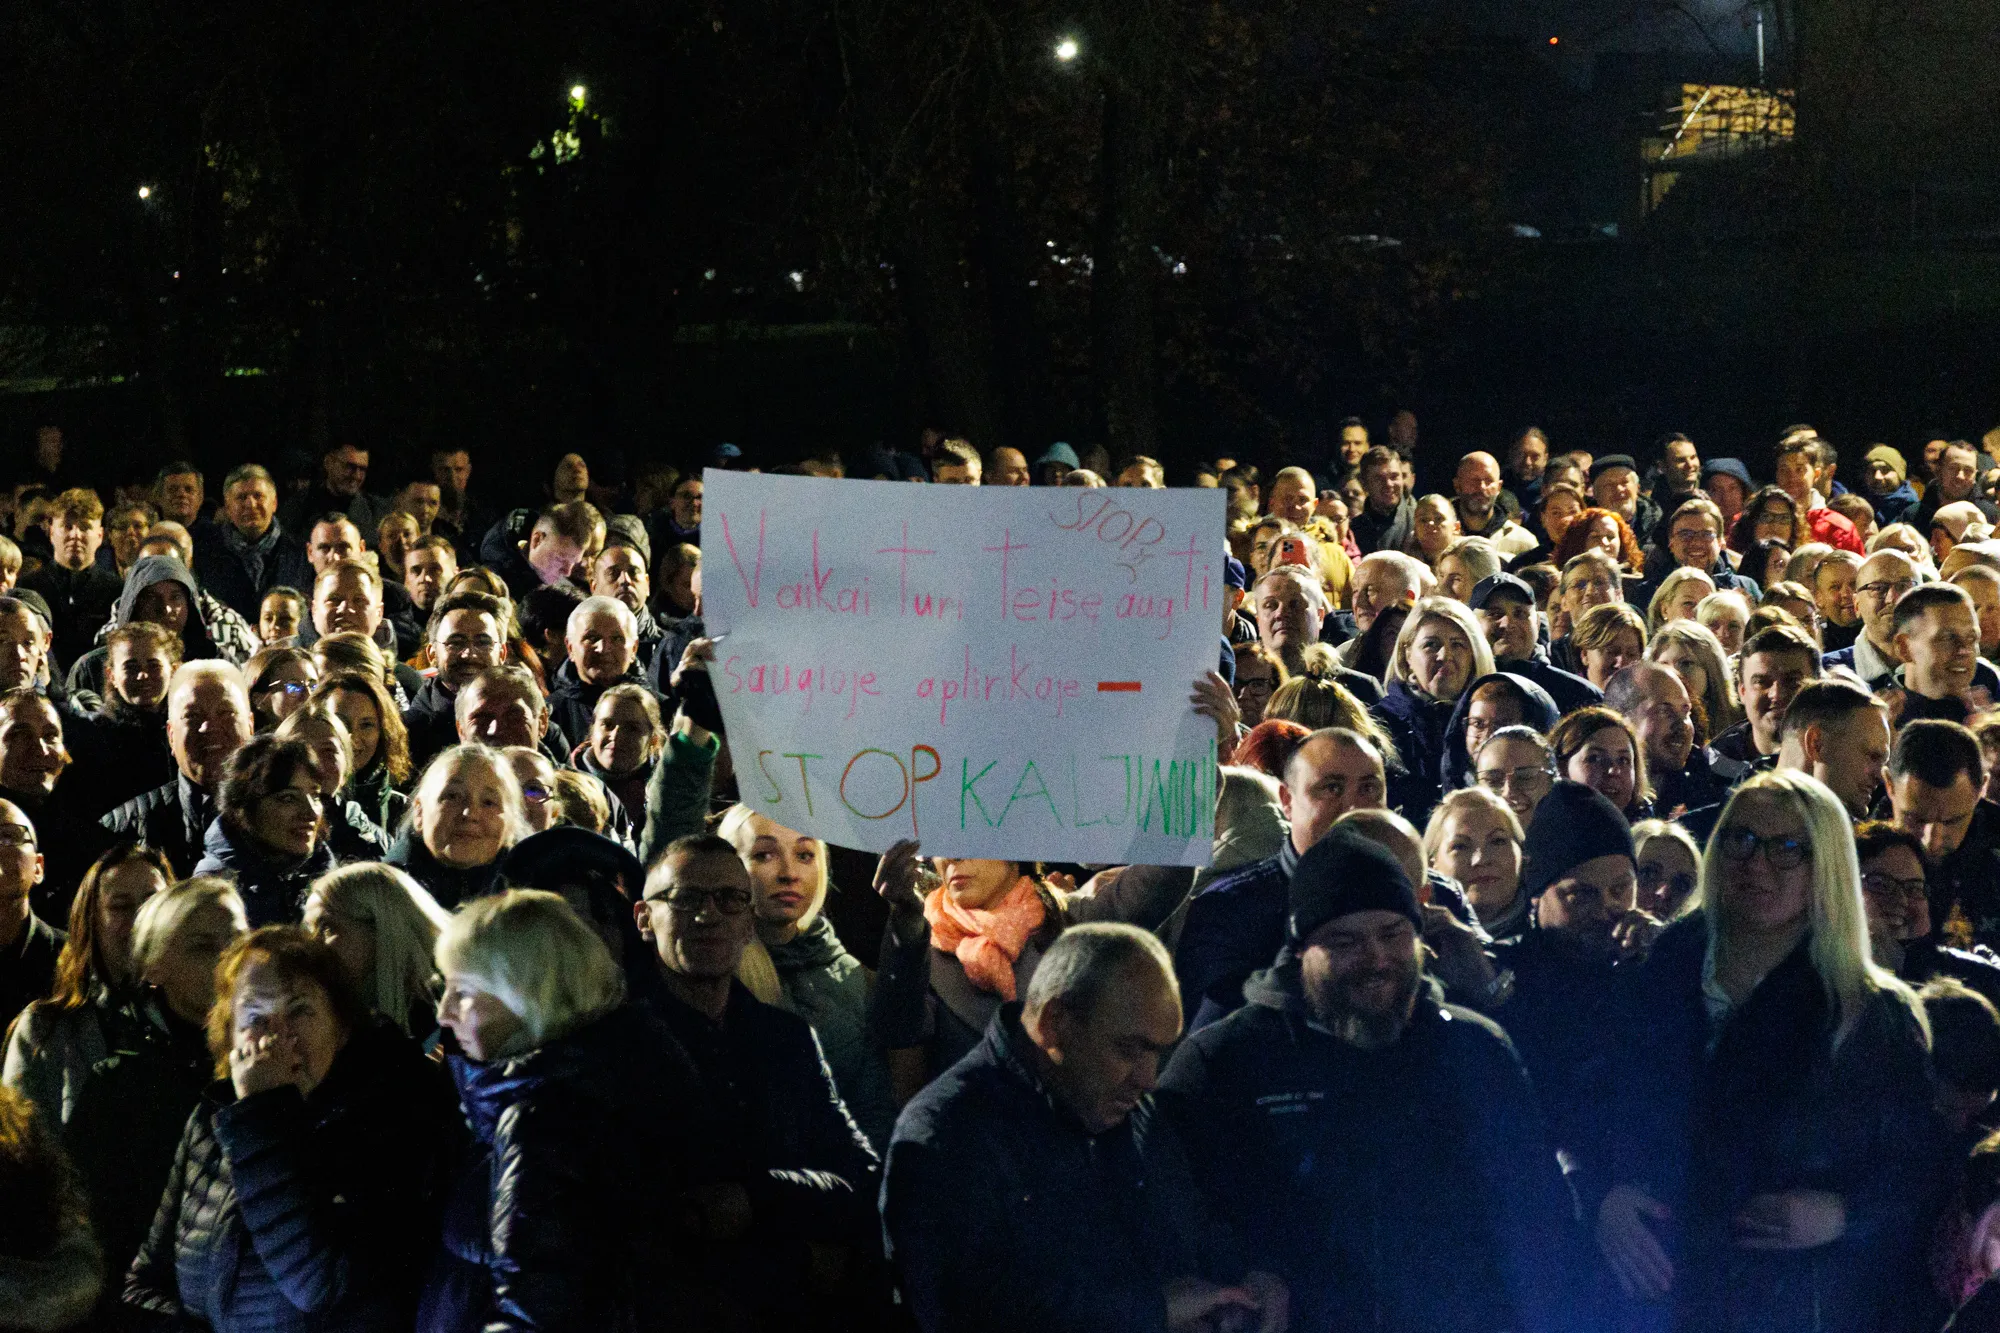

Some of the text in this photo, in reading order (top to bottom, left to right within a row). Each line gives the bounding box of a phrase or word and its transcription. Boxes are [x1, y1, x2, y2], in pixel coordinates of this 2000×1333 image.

[1049, 491, 1165, 549] STOP
[720, 508, 870, 616] Vaikai
[1115, 533, 1209, 641] augti
[758, 744, 942, 837] STOP
